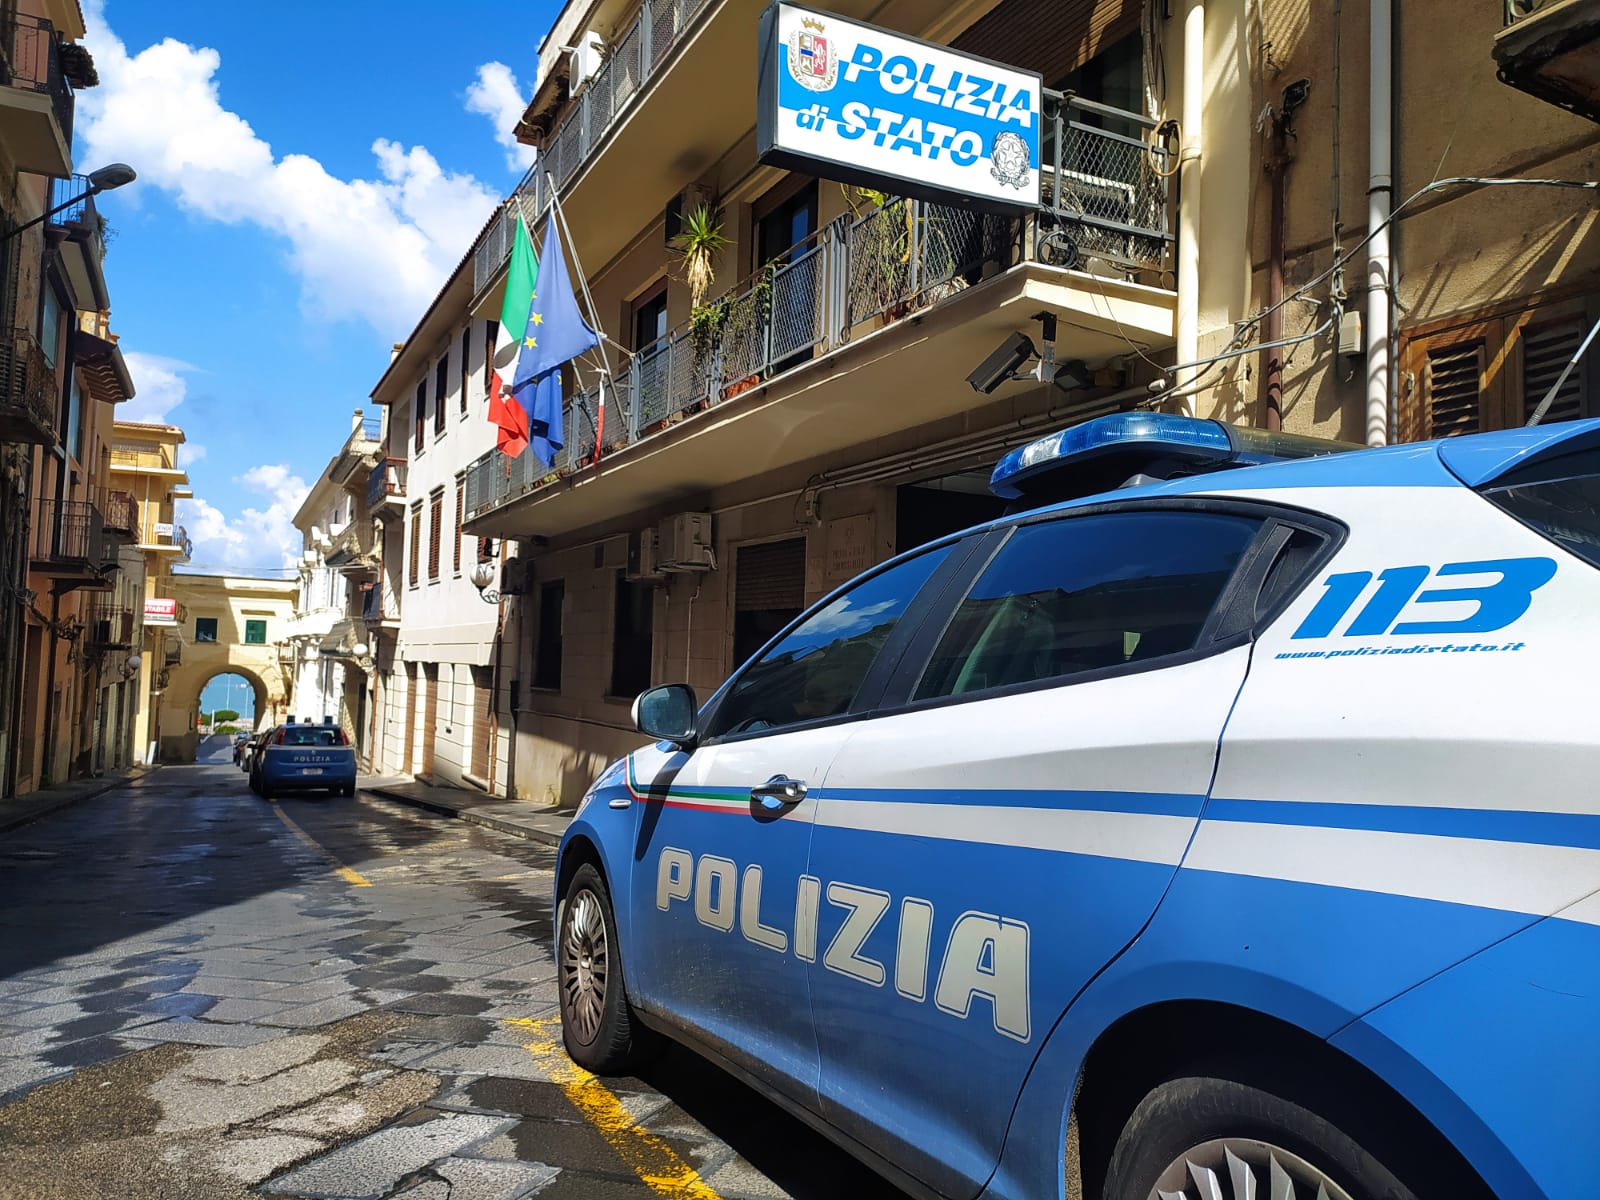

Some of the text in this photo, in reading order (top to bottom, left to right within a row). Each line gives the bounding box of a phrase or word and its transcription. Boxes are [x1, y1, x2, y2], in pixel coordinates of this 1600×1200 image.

[844, 43, 1032, 128] POLIZIA
[796, 101, 983, 167] di STATO
[1290, 557, 1558, 640] 113
[1274, 642, 1526, 660] www.poliziadistato.it
[656, 846, 1032, 1044] POLIZIA
